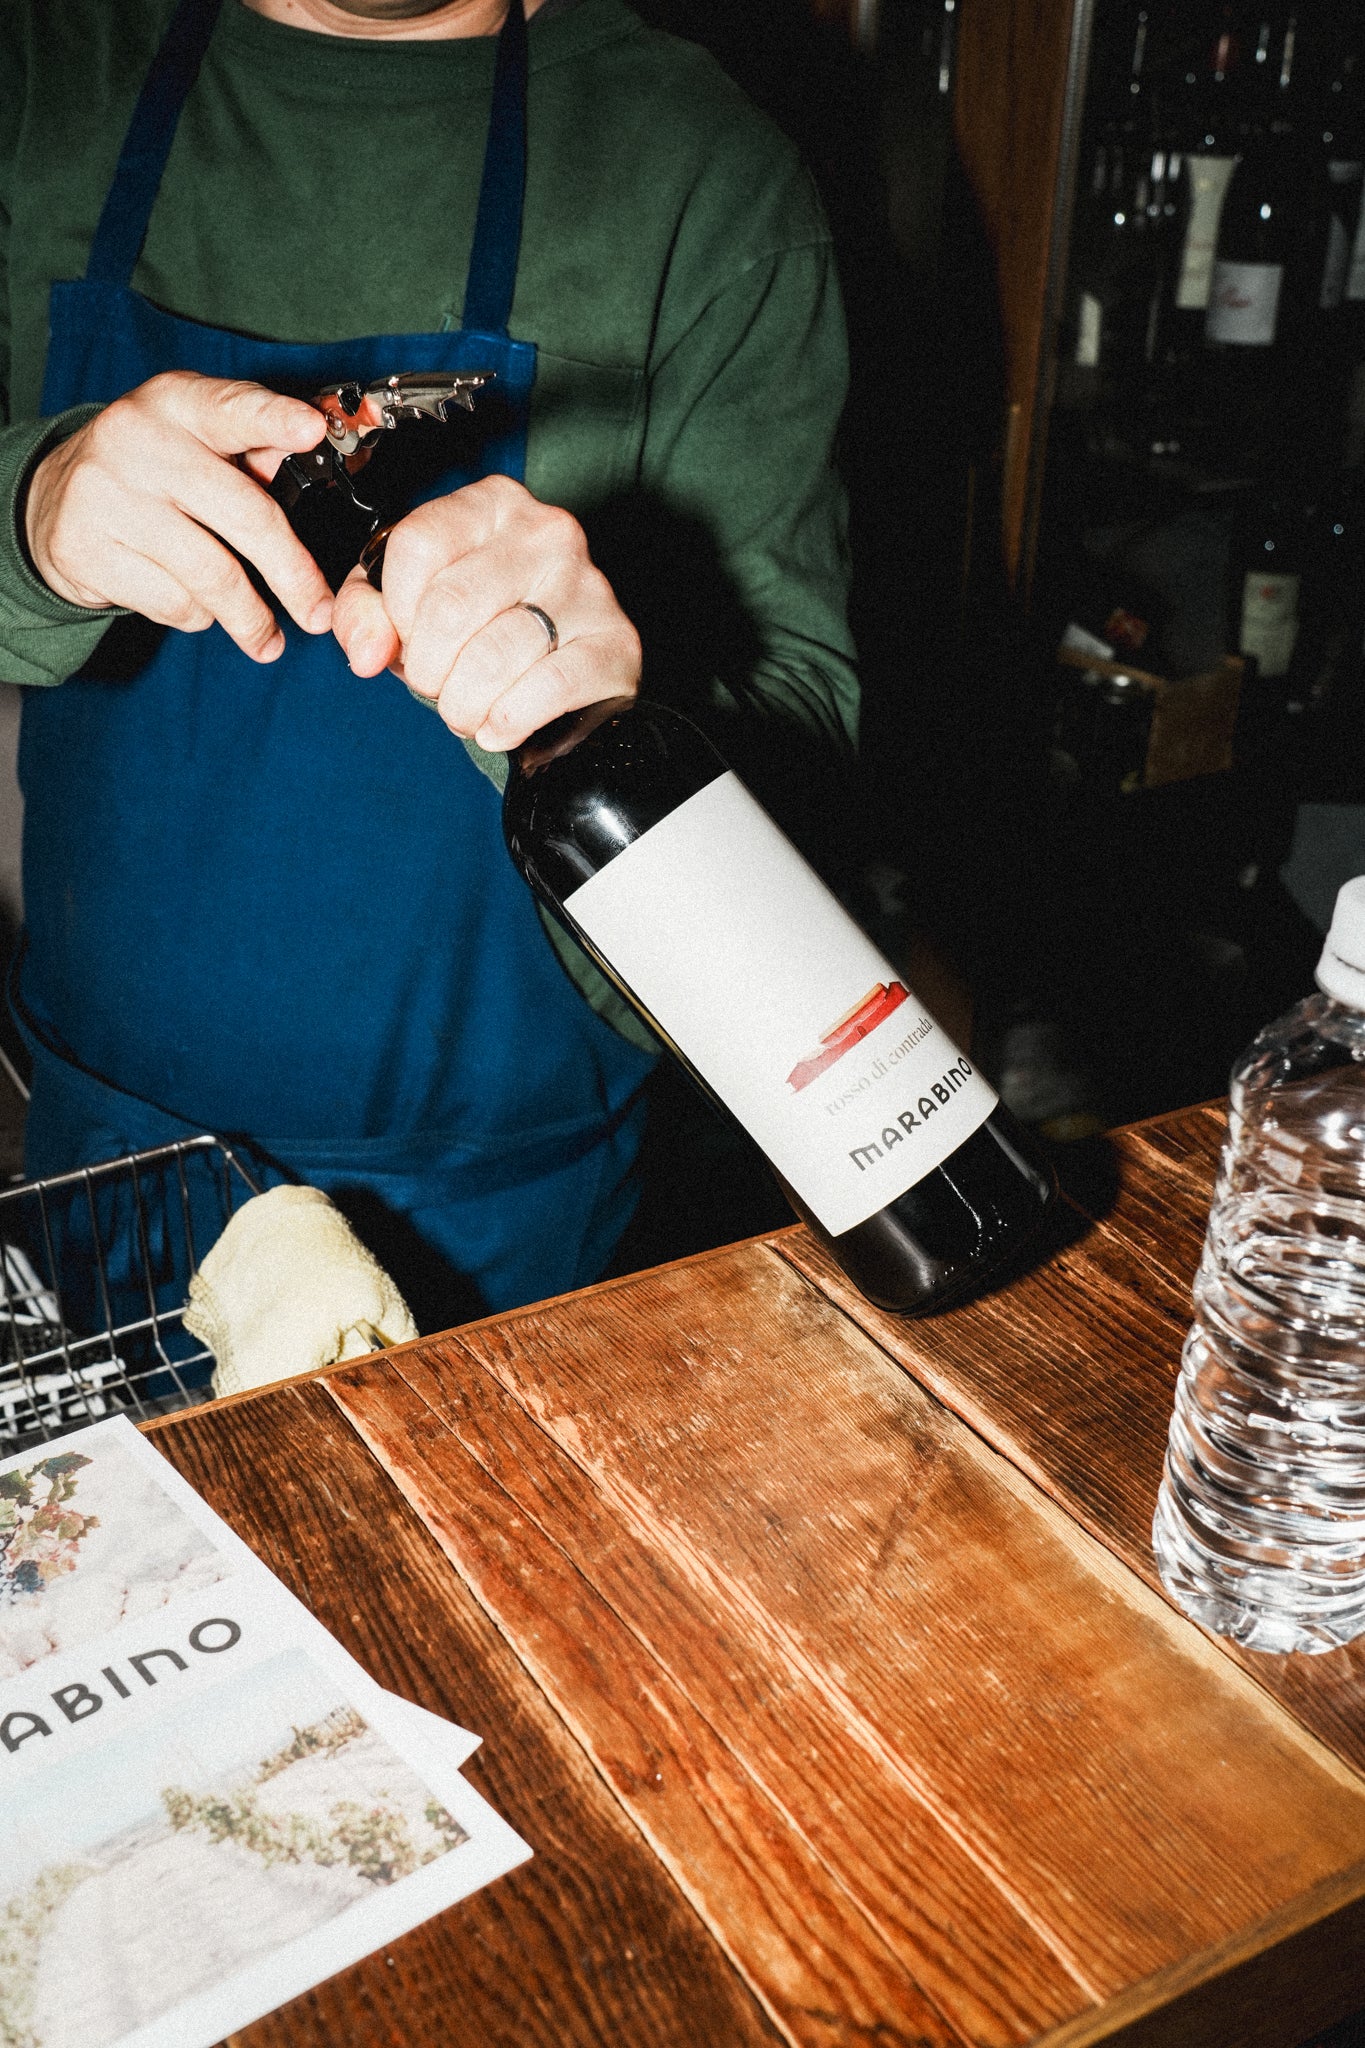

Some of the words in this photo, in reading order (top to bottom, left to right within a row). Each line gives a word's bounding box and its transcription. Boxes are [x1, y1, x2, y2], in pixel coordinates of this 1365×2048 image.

[826, 1077, 870, 1116] rosso
[871, 1058, 888, 1079] di
[888, 1018, 933, 1065] contrada
[848, 1057, 973, 1171] MARABINO
